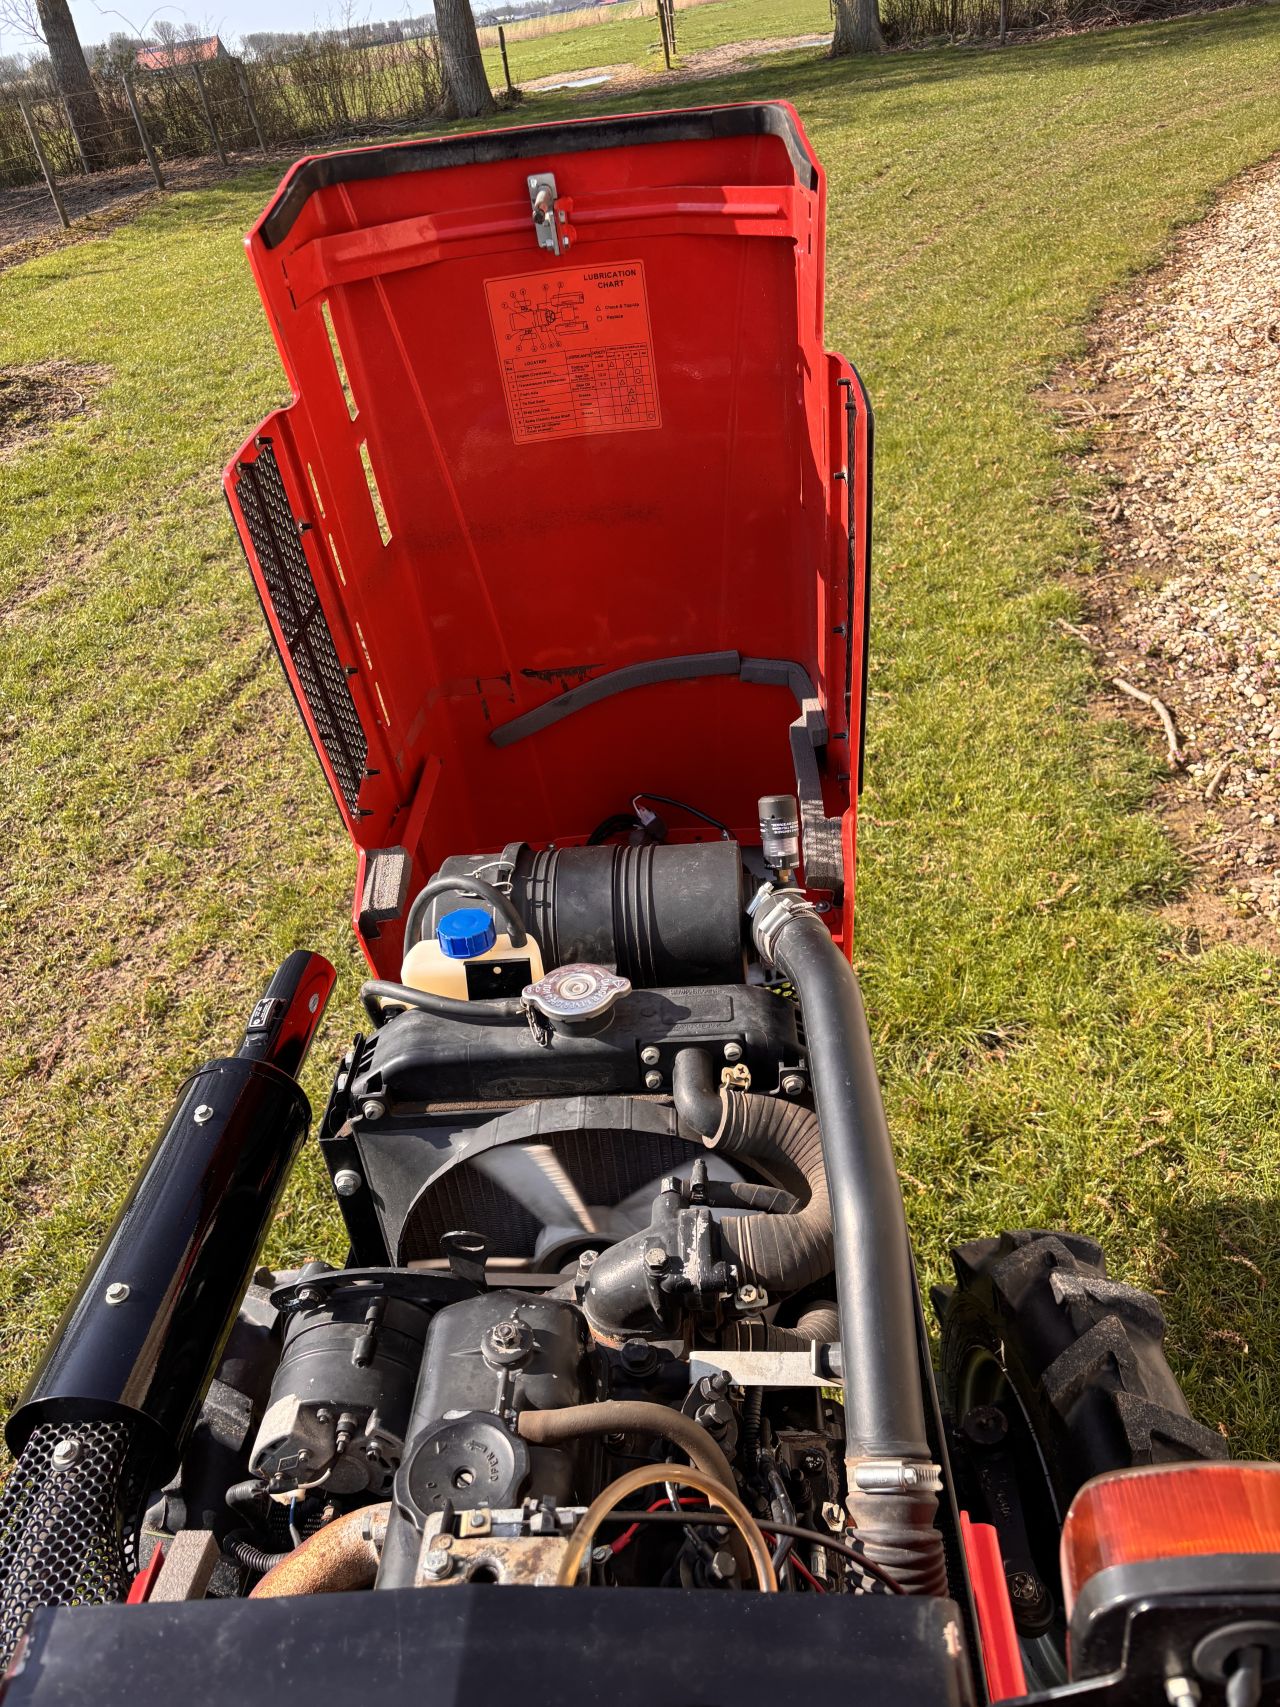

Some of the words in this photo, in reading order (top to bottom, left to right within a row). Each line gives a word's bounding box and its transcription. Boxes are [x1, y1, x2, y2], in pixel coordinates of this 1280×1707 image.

[584, 269, 636, 280] LUBRICATION
[598, 280, 624, 288] CHART
[592, 978, 609, 1002] DANGER
[487, 1450, 499, 1482] OPEN
